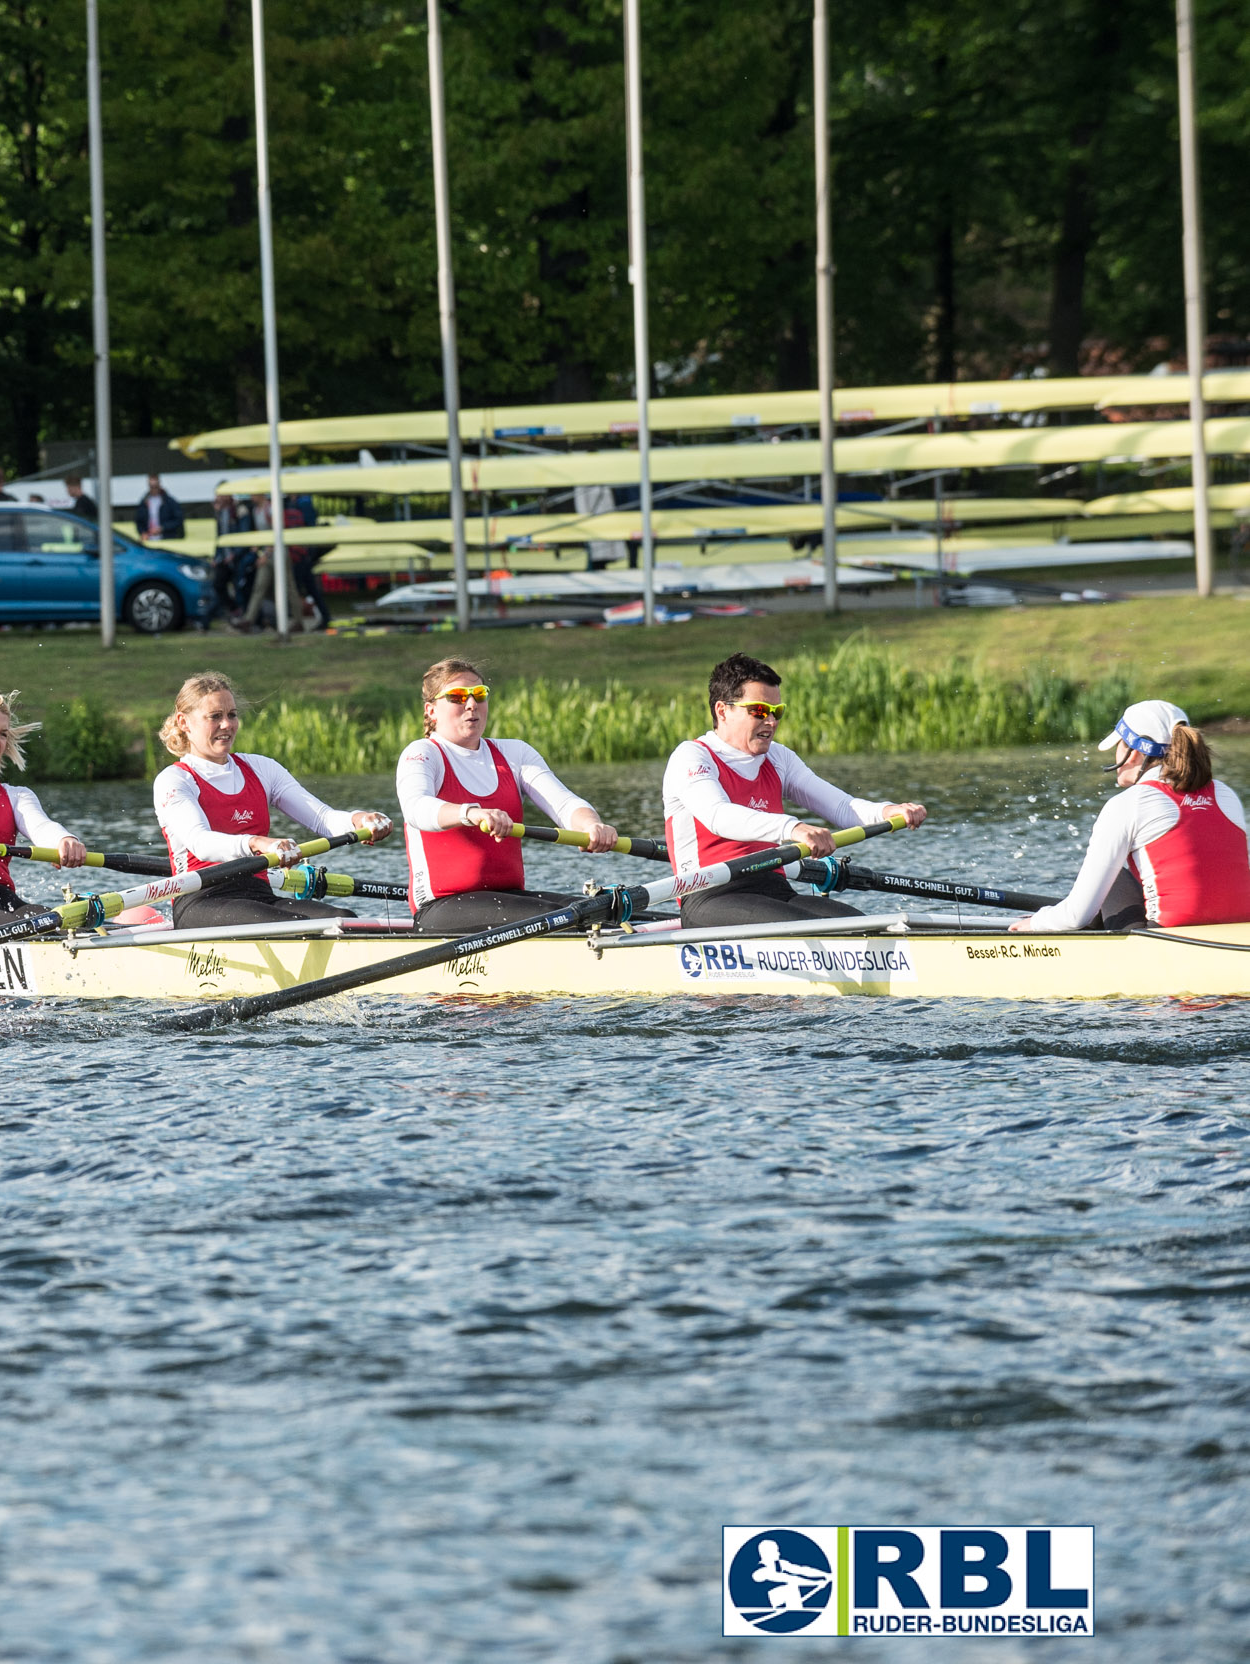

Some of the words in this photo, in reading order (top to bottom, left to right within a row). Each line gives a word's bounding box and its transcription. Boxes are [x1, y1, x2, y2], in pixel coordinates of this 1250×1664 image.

[1140, 741, 1154, 754] NK
[1180, 794, 1213, 806] Melitta
[143, 878, 182, 904] Melitta
[362, 884, 390, 895] STARK.
[673, 872, 709, 896] Melitta
[884, 876, 913, 888] STARK.
[914, 880, 954, 894] SCHNELL.
[955, 886, 974, 897] GUT.
[984, 890, 1000, 899] RBL
[37, 917, 52, 926] RBL
[553, 915, 569, 925] RBL
[11, 922, 31, 935] GUT.
[457, 938, 486, 954] STARK.
[486, 927, 525, 946] SCHNELL.
[525, 922, 545, 935] GUT.
[706, 944, 754, 971] RBL
[757, 950, 911, 972] RUDER-BUNDESLIGA
[966, 945, 1021, 959] Bessel-R.C.
[1023, 944, 1061, 958] Minden
[184, 944, 226, 978] Melitta
[443, 954, 488, 977] Melitta
